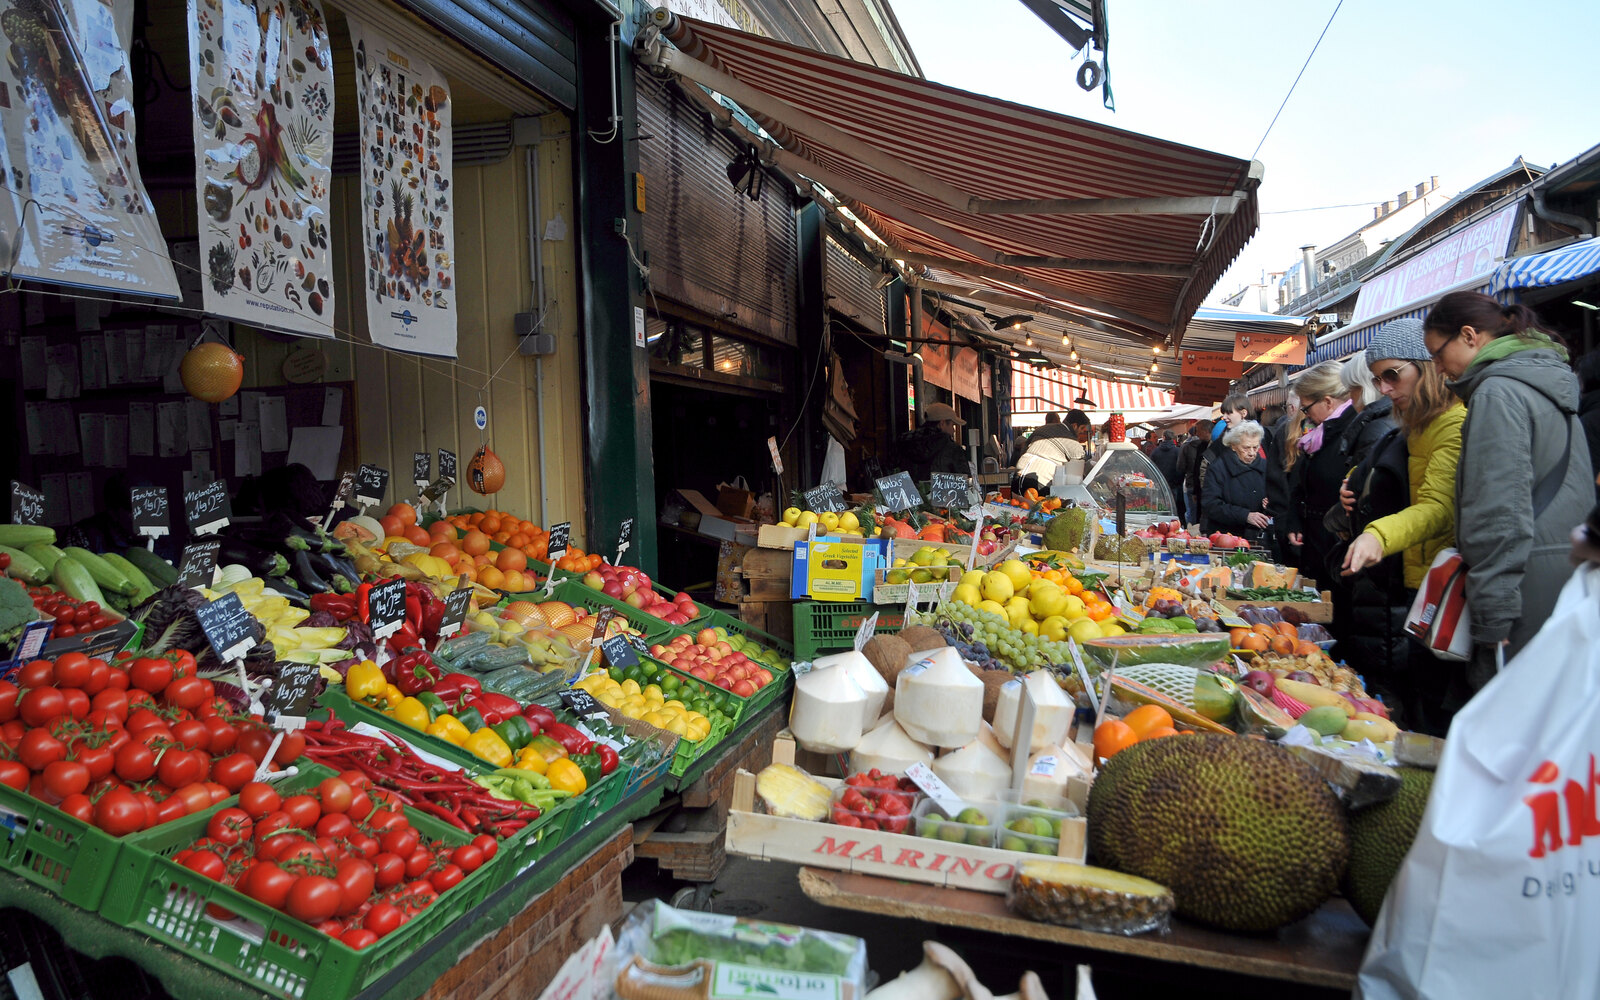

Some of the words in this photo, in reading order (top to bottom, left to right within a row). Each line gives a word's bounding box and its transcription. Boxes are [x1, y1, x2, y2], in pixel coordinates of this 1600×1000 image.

[245, 298, 296, 315] www.reputation.nl
[371, 477, 382, 489] 3
[813, 836, 1017, 881] MARINO
